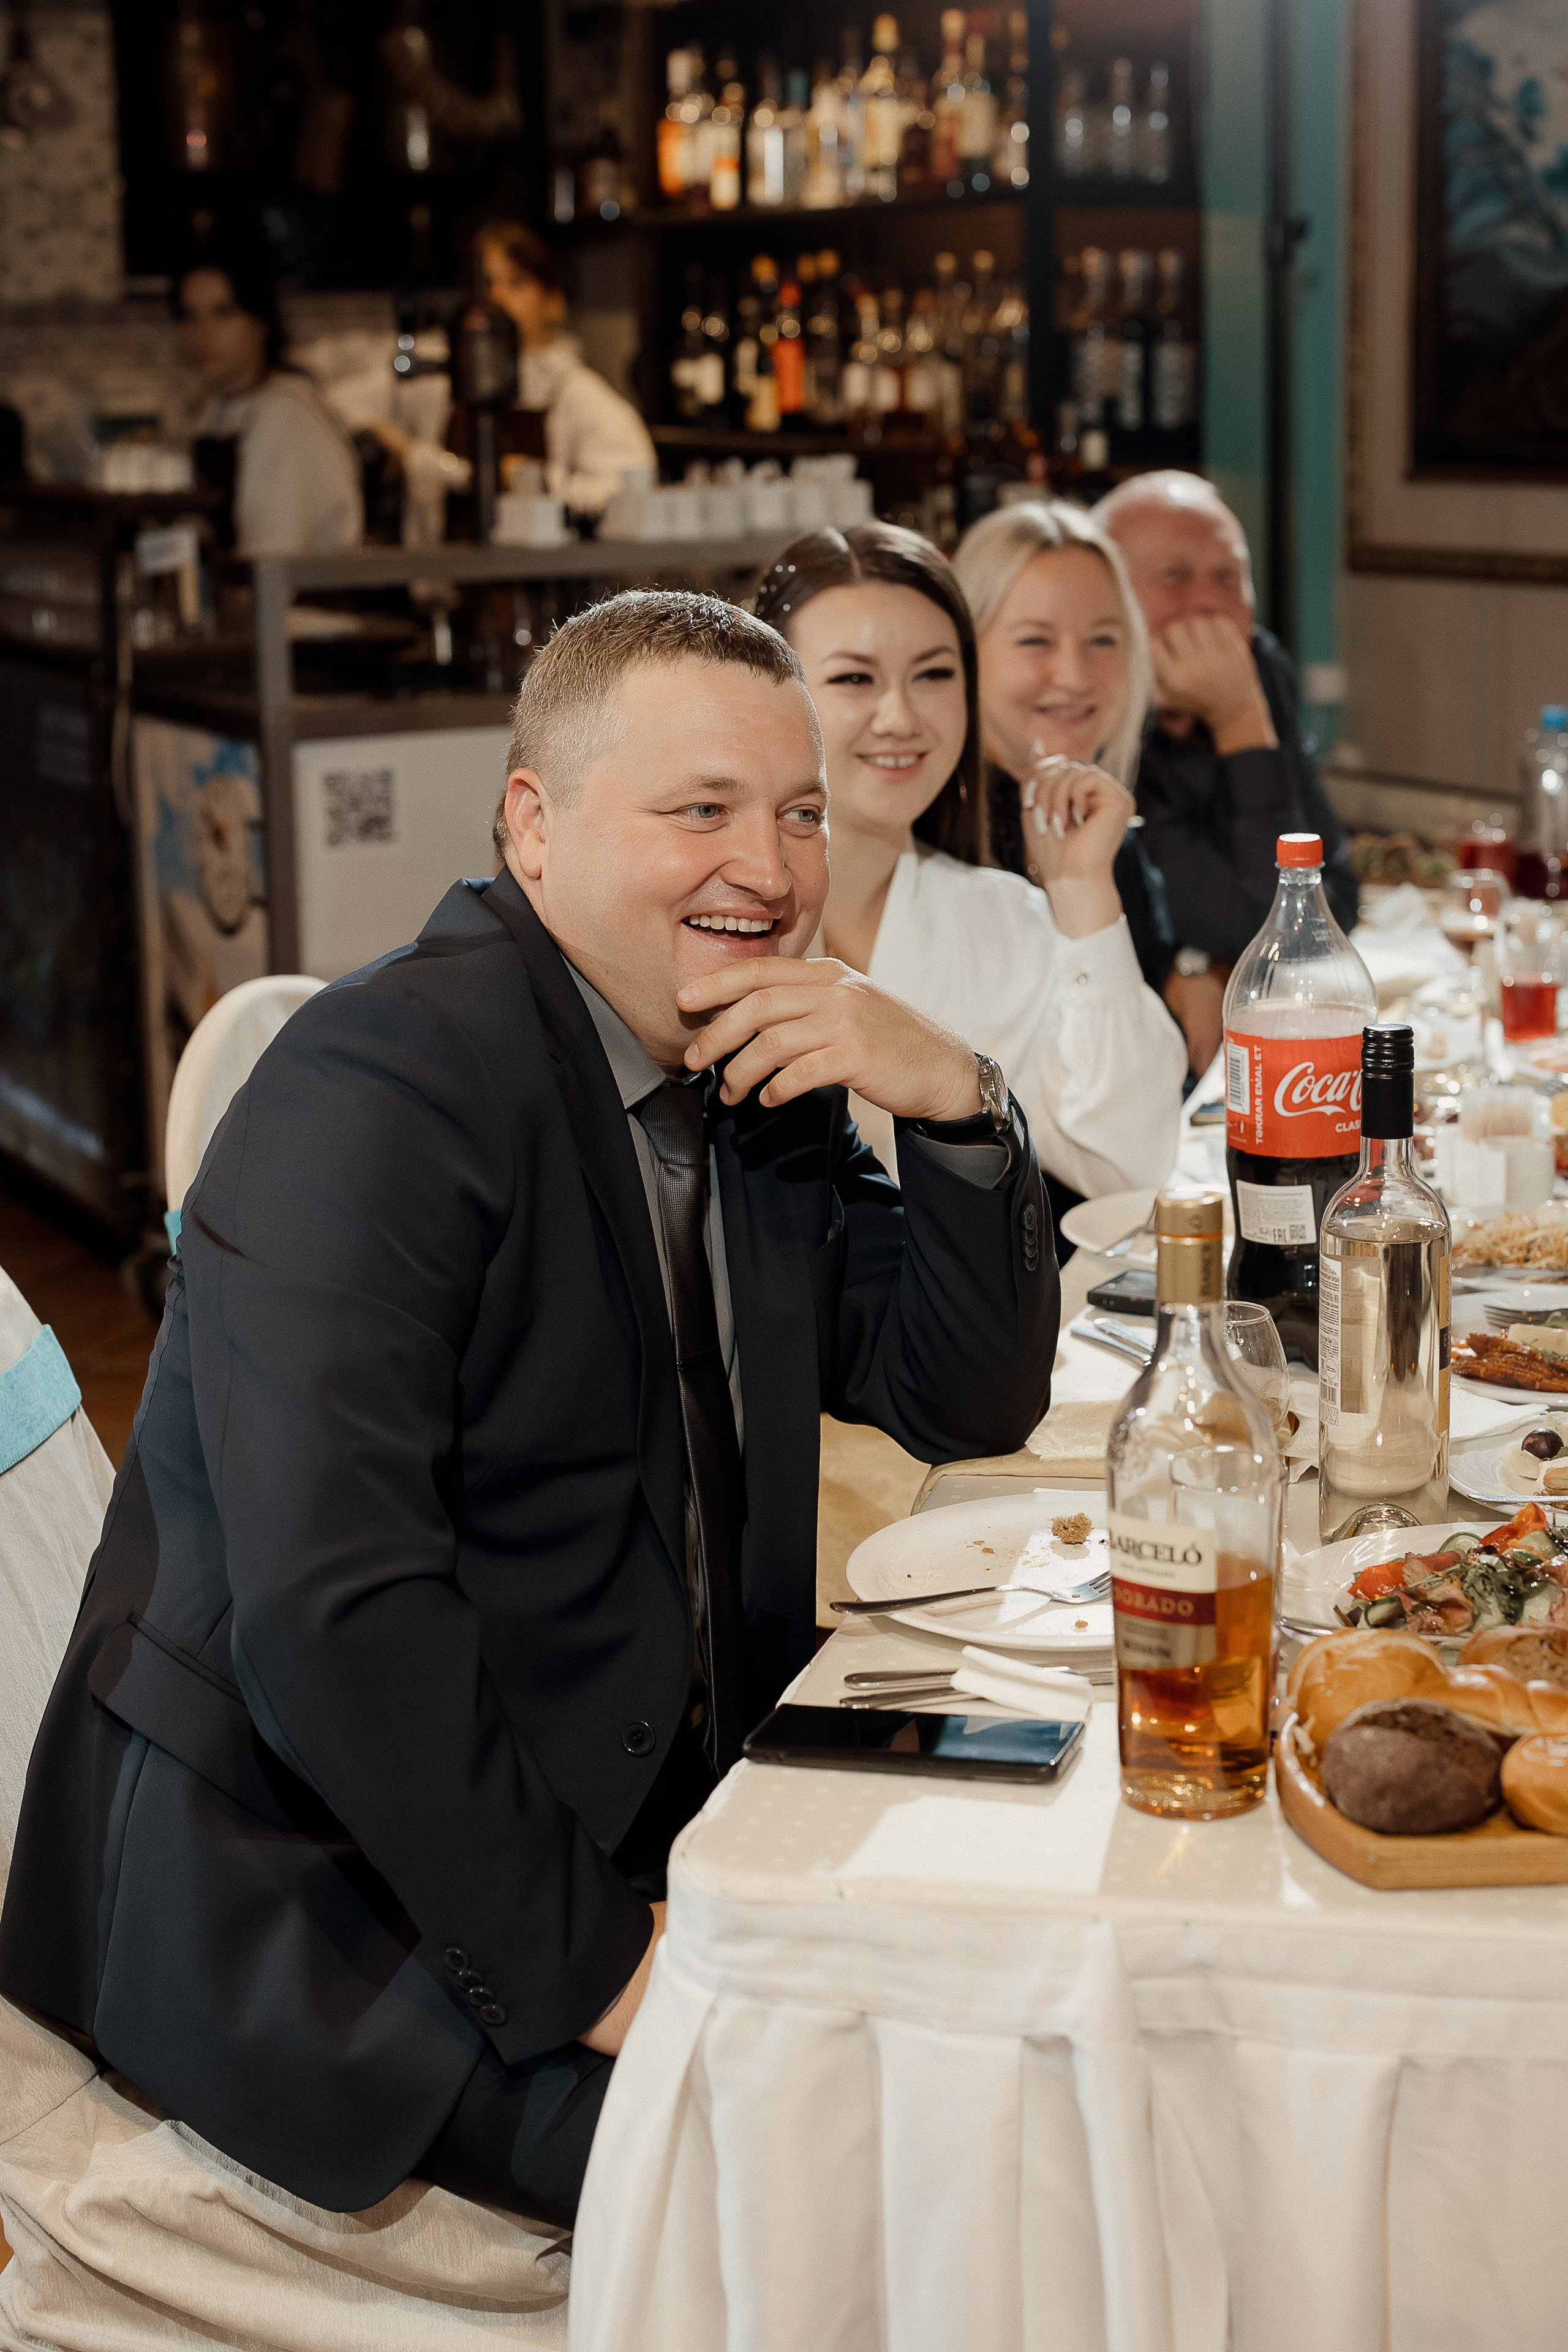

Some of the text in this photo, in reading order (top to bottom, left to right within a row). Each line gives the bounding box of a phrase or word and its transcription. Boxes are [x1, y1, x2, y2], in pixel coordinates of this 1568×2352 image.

[1254, 1045, 1262, 1061] ET
[1273, 1061, 1361, 1117] Coca-
[1335, 1119, 1361, 1133] CLAS
[1109, 1529, 1202, 1567] ARCELÓ
